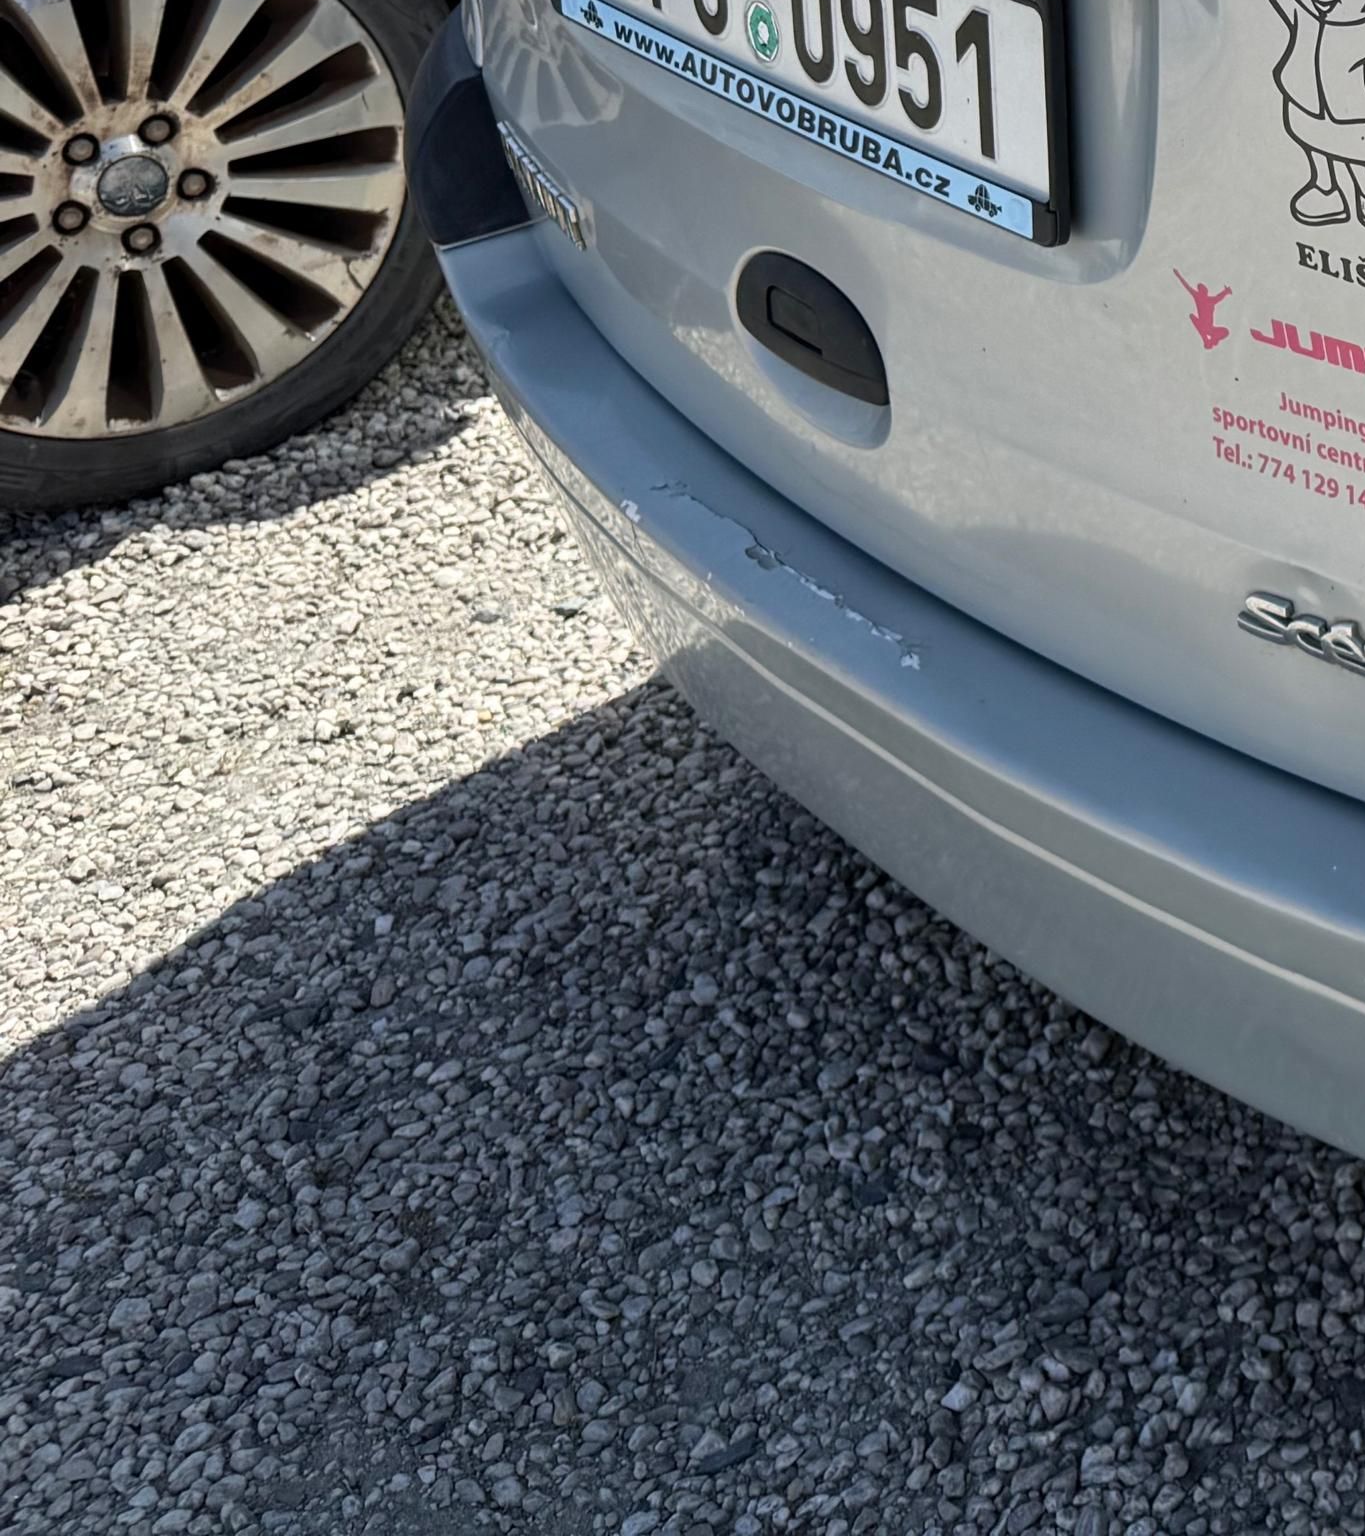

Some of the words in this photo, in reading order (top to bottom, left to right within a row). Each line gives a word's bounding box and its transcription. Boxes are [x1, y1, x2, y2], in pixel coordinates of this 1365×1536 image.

[614, 21, 950, 198] www.AUTOVOBRUBA.cz
[1212, 407, 1311, 453] sportovní
[1212, 436, 1253, 469] Tel.:
[1258, 453, 1295, 484] 774
[1302, 470, 1339, 498] 129
